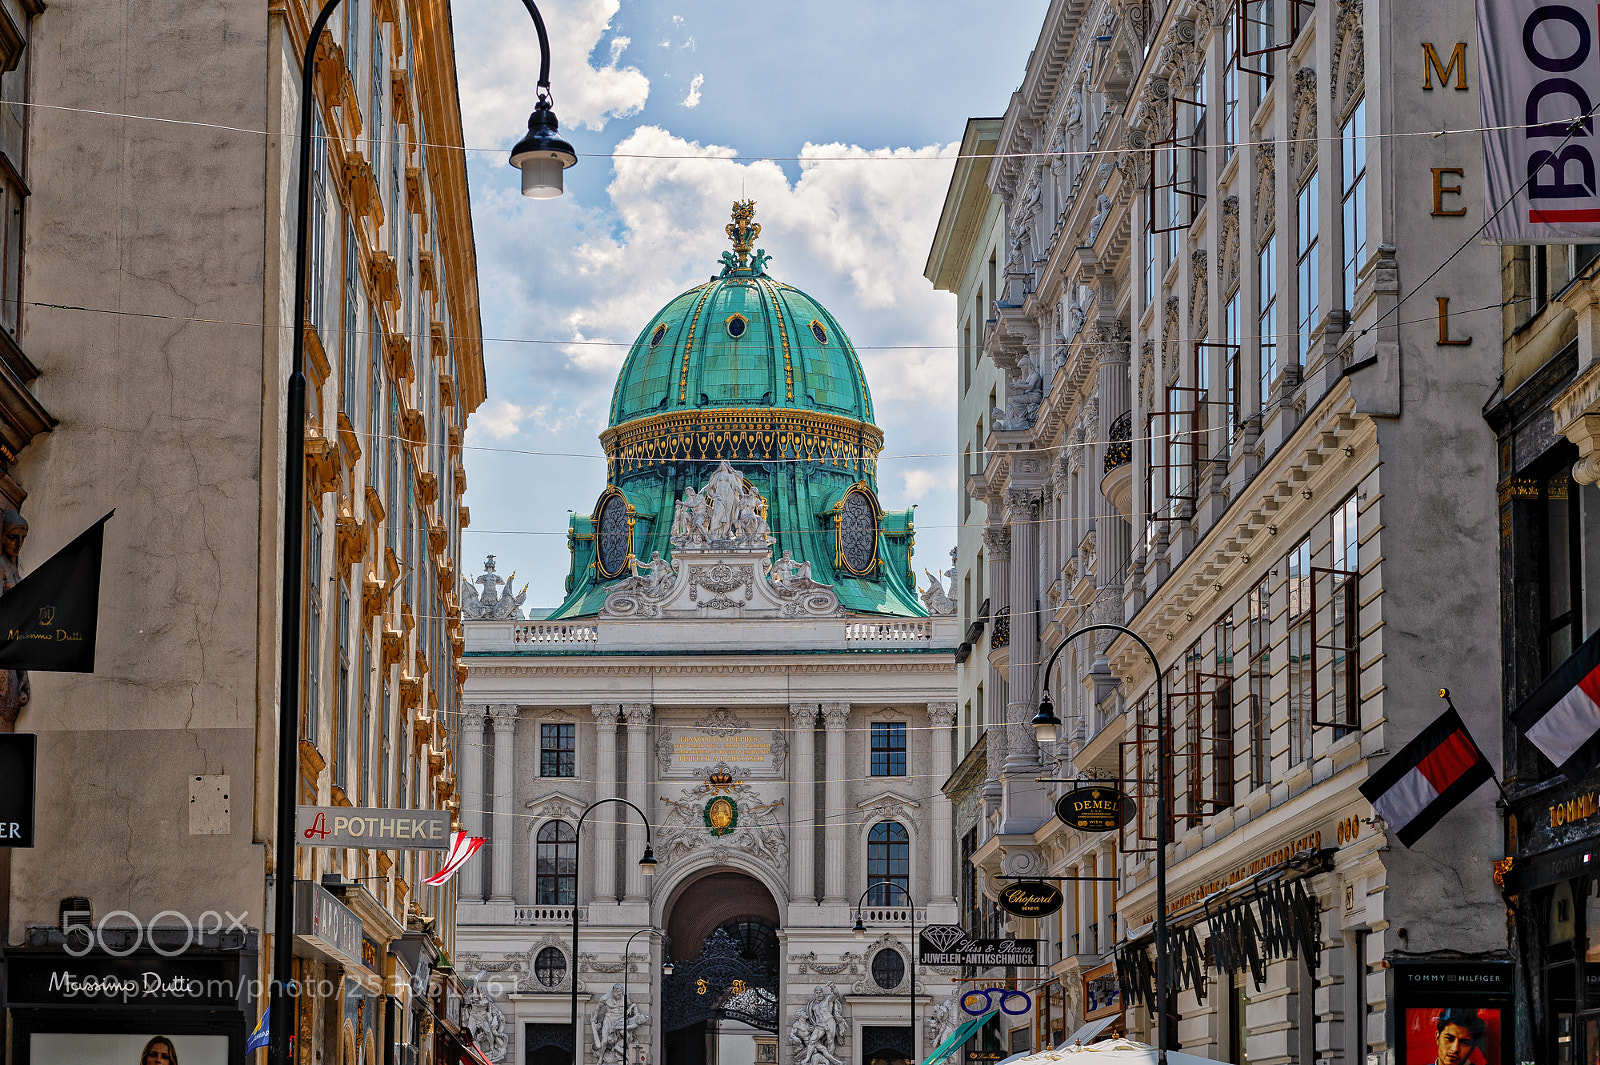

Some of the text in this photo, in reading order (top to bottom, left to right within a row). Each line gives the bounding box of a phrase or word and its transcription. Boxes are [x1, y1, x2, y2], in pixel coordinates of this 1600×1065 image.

[1523, 5, 1596, 200] BDO
[1421, 42, 1473, 347] MEL
[7, 629, 83, 641] Massimo Dutti
[1073, 800, 1119, 811] DEMEL
[1549, 792, 1595, 828] TOMMY
[304, 812, 444, 839] APOTHEKE
[1005, 889, 1056, 906] Chopard
[956, 939, 981, 953] Kiss
[985, 945, 995, 953] &
[921, 953, 1034, 965] JUWELEN ANTIKSCHMUCK
[49, 971, 193, 993] Massimo Dutti
